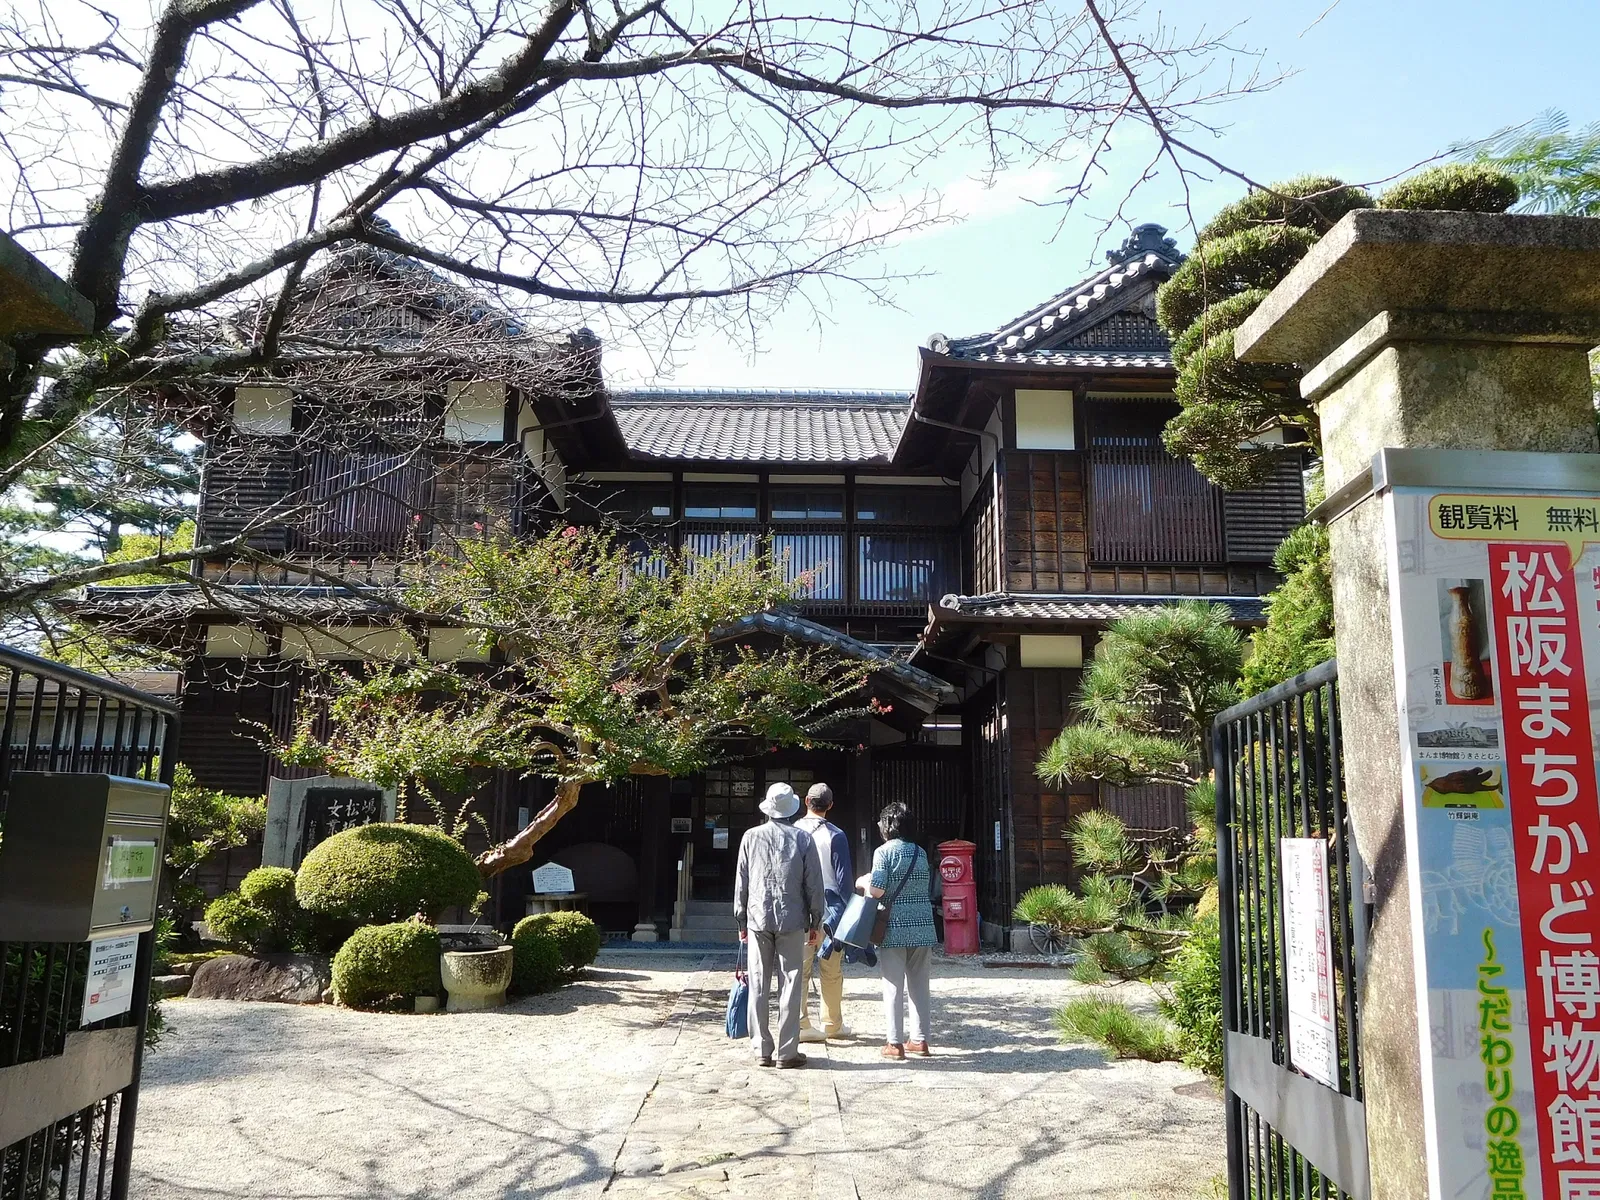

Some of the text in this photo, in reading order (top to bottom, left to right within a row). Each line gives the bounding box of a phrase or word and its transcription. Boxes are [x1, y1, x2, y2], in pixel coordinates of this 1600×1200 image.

[1438, 503, 1600, 533] 観覧料 無料
[1419, 751, 1501, 760] まんま博物館うきさとむら
